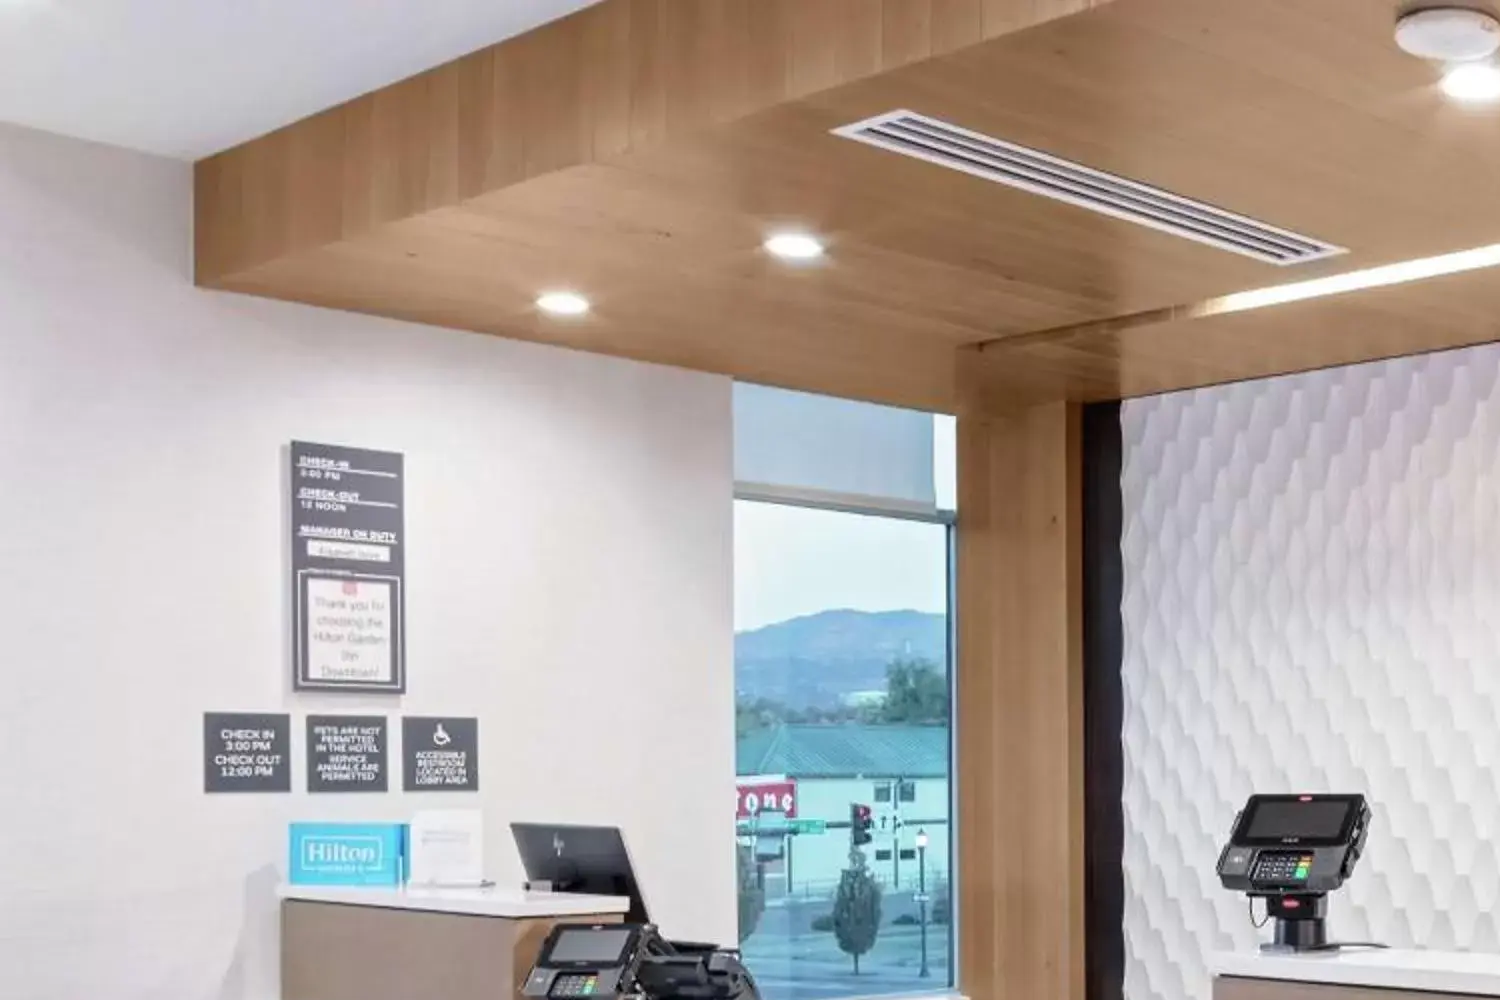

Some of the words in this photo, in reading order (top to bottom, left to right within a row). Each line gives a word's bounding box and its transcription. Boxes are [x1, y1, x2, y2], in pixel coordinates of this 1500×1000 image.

[370, 530, 397, 543] DUTY
[221, 729, 260, 739] CHECK
[262, 729, 275, 739] IN
[225, 741, 250, 751] 3:00
[252, 741, 271, 751] PM
[215, 754, 255, 765] CHECK
[256, 754, 281, 765] OUT
[221, 766, 252, 777] 12:00
[254, 766, 274, 776] PM
[321, 772, 375, 781] PERMITTED
[308, 842, 376, 863] Hilton
